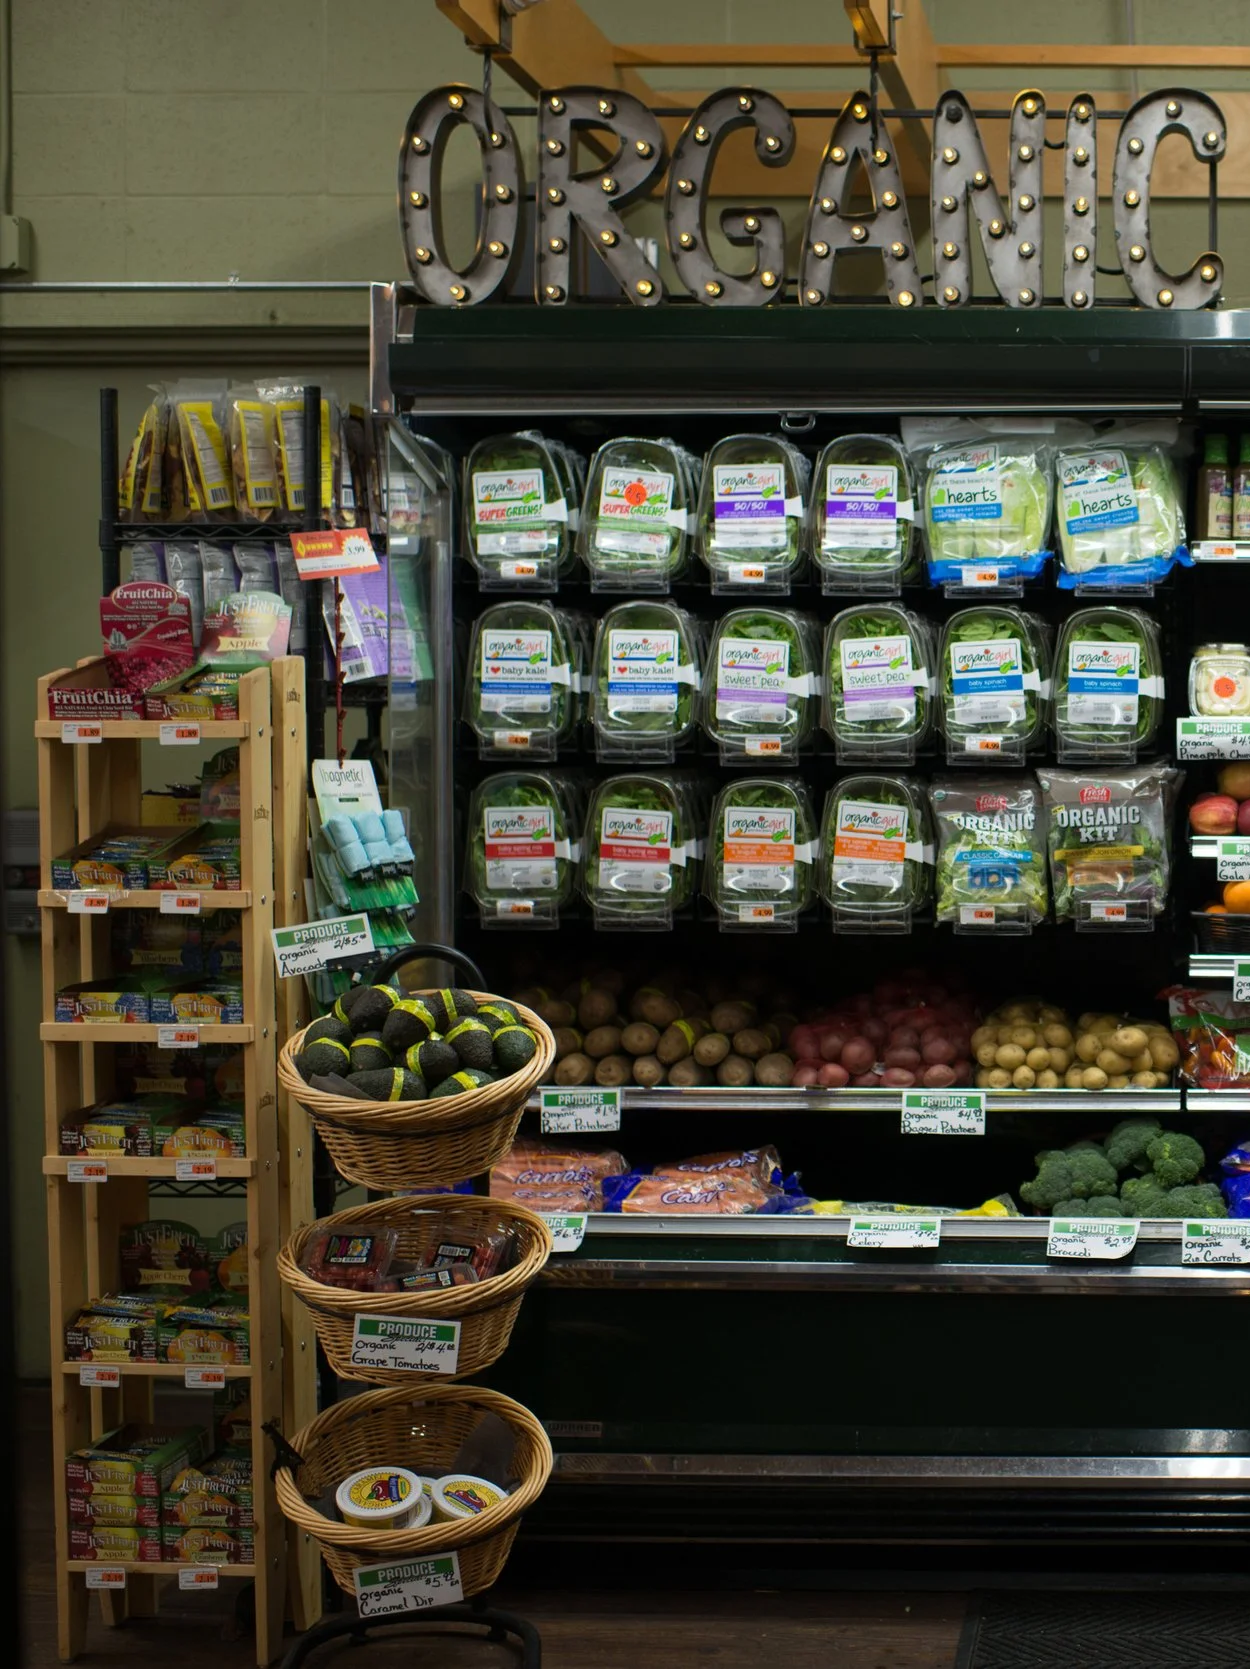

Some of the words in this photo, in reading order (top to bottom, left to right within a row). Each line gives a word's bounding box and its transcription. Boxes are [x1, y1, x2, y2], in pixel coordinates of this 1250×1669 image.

[399, 82, 1227, 308] ORGANIC
[947, 487, 997, 504] hearts
[1082, 494, 1132, 517] hearts
[116, 588, 173, 600] FruitChia
[502, 665, 523, 676] baby
[525, 665, 547, 675] kale!
[627, 666, 650, 677] baby
[651, 665, 674, 675] kale!
[724, 674, 757, 687] sweet
[760, 677, 780, 689] pea
[849, 671, 884, 684] sweet
[886, 673, 906, 685] pea
[53, 691, 133, 705] FruitChia
[180, 729, 198, 738] 1.89
[1180, 749, 1225, 760] Pineapple
[1057, 805, 1140, 828] ORGANIC
[1079, 826, 1119, 843] KIT
[1219, 869, 1245, 880] Gala
[294, 922, 349, 943] PRODUCE
[558, 1094, 604, 1105] PRODUCE
[921, 1096, 967, 1107] PRODUCE
[1070, 1223, 1120, 1233] PRODUCE
[1204, 1250, 1242, 1262] Carrots
[378, 1322, 437, 1339] PRODUCE
[355, 1340, 396, 1353] Organic
[352, 1350, 388, 1368] Grape
[389, 1355, 440, 1371] Tomatoes
[378, 1561, 437, 1582] PRODUCE
[360, 1597, 409, 1616] Caramel
[413, 1594, 434, 1607] Dip
